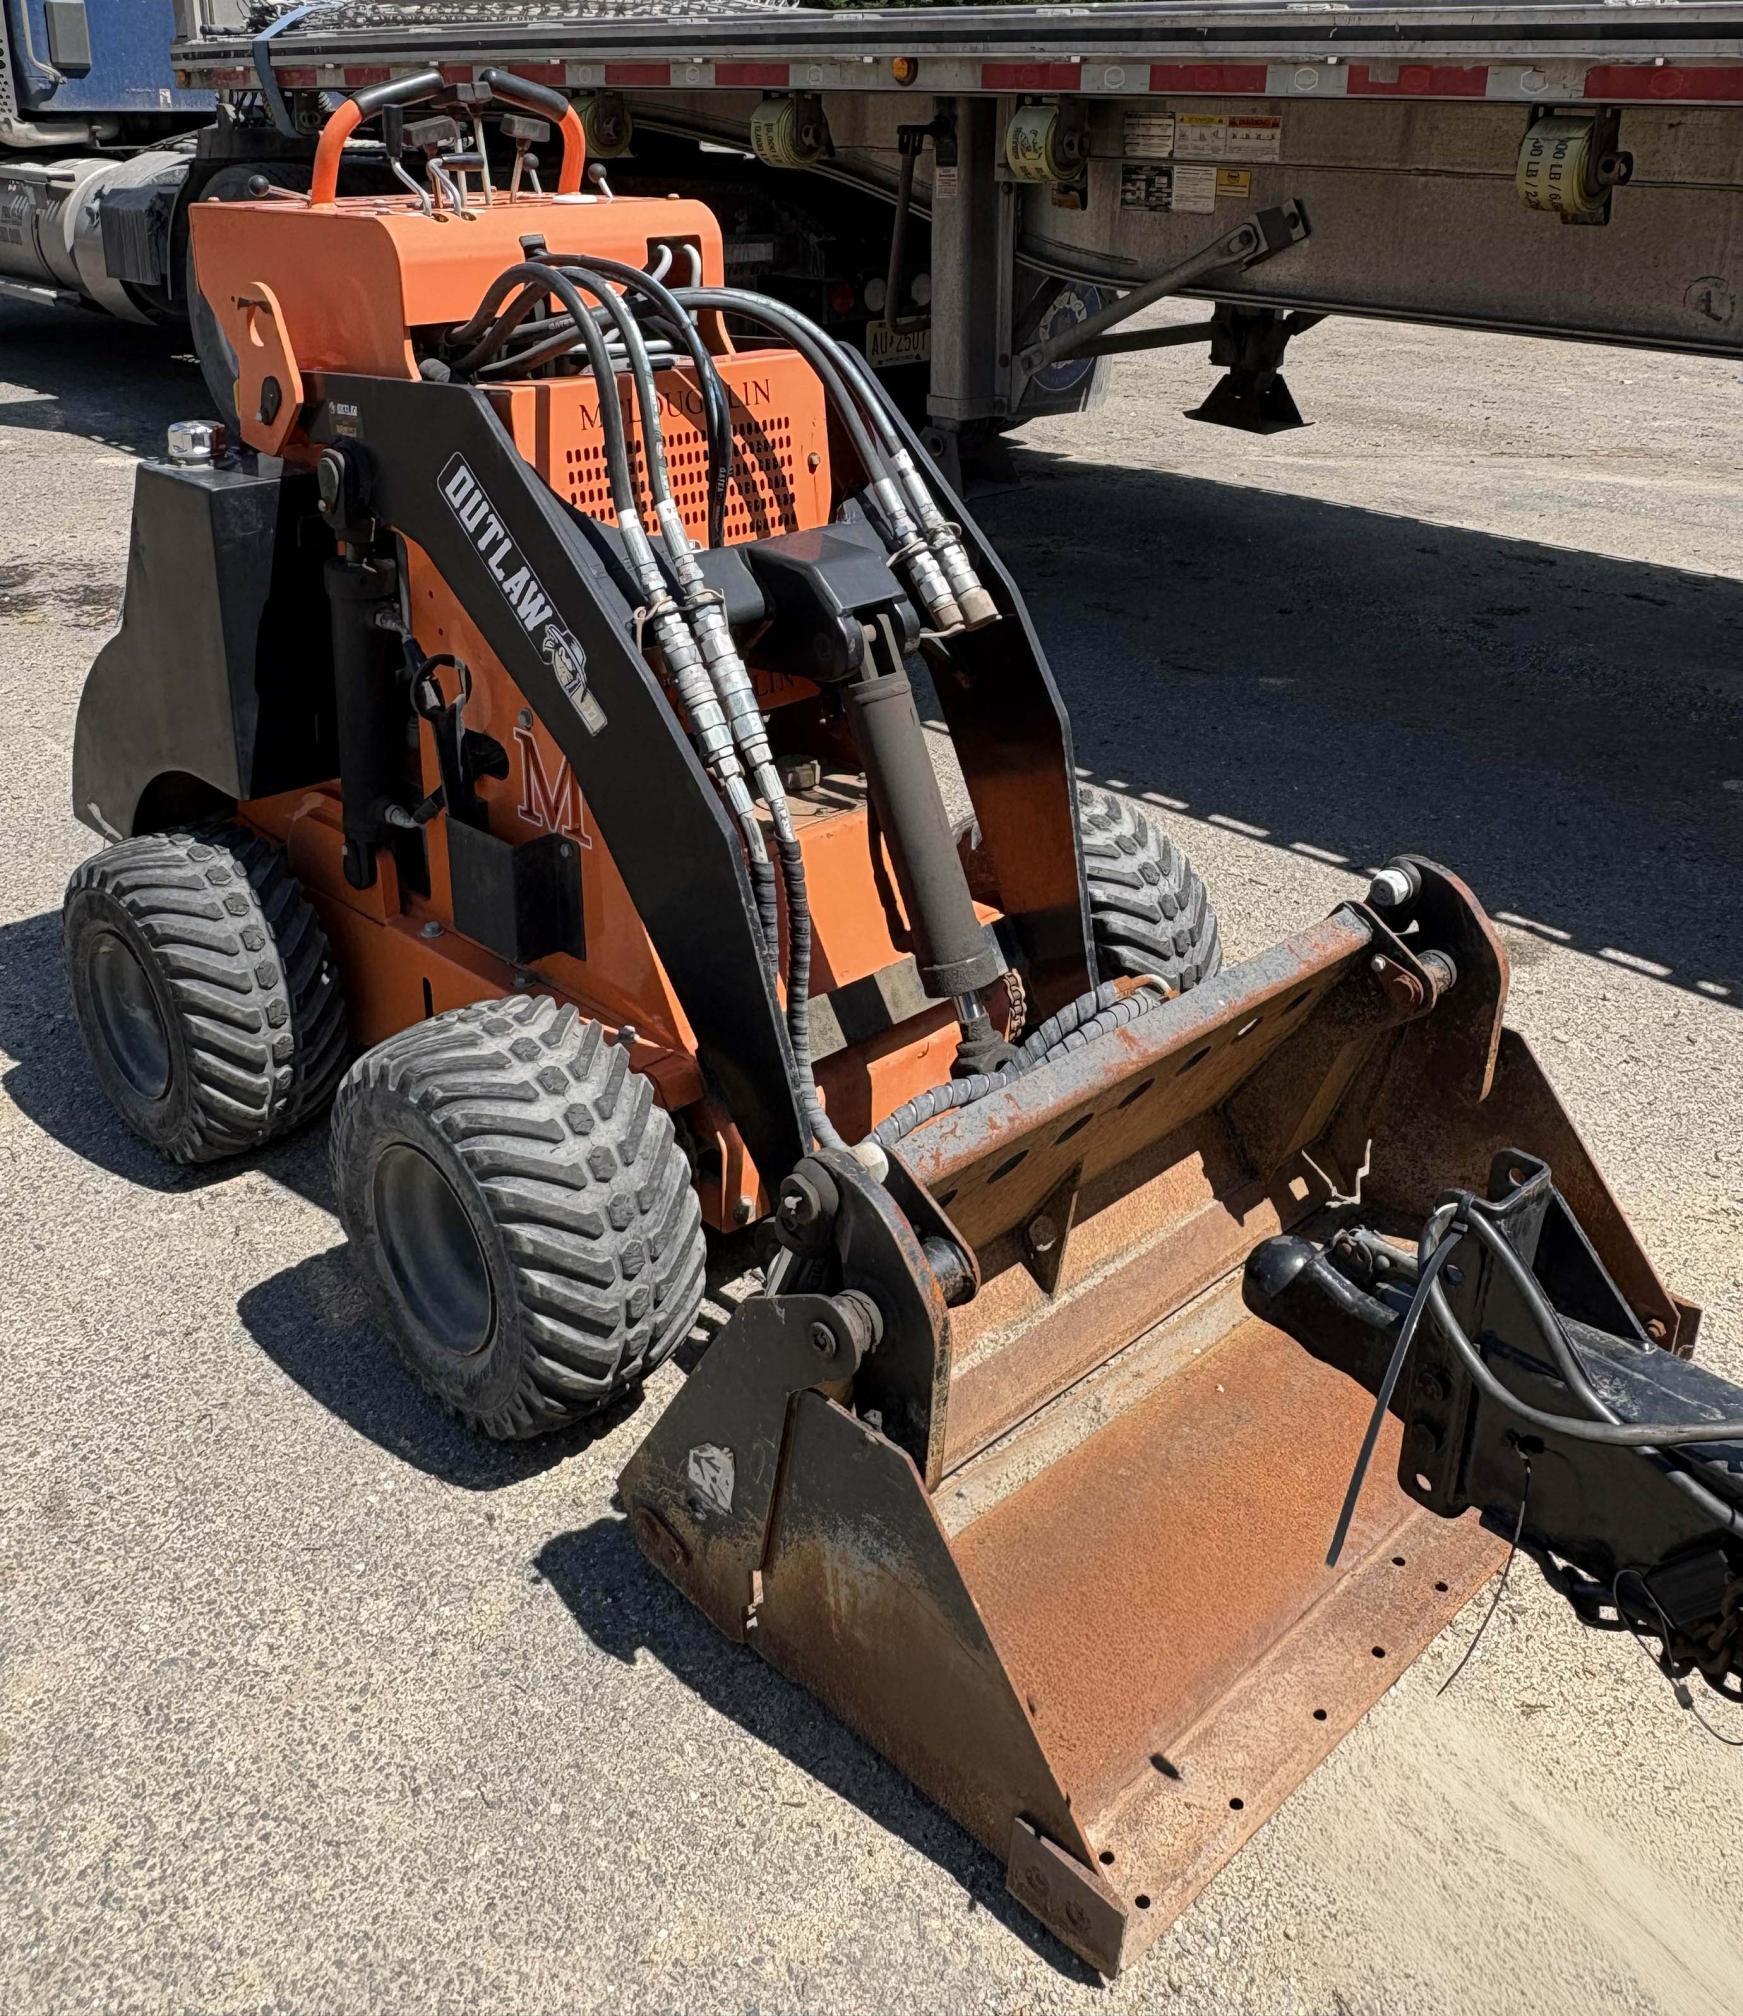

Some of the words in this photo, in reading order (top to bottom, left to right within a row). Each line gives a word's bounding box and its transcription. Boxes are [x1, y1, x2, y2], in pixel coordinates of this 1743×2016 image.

[1526, 161, 1540, 178] LB
[1549, 164, 1563, 181] LB
[872, 332, 887, 355] AU
[445, 465, 553, 632] OUTLAW
[513, 726, 593, 850] M
